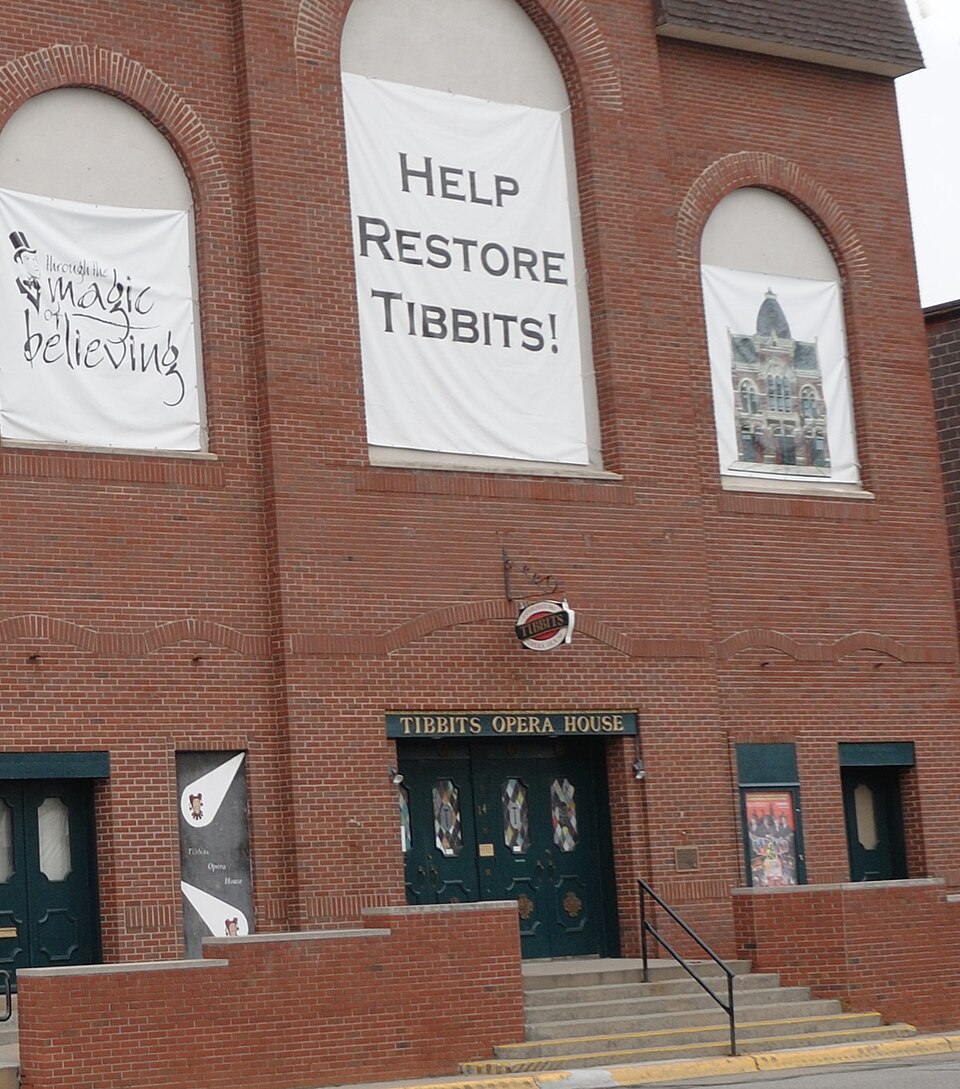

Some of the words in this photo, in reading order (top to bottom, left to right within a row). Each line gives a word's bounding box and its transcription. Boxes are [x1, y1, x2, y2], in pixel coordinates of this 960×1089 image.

[399, 152, 519, 207] HELP
[46, 254, 90, 284] through
[92, 263, 109, 278] the
[357, 215, 568, 286] RESTORE
[44, 302, 64, 330] of
[48, 269, 156, 343] magic
[371, 288, 559, 354] TIBBITS!
[24, 308, 185, 407] believing
[400, 716, 482, 734] TIBBITS
[492, 715, 554, 733] OPERA
[564, 714, 624, 732] HOUSE
